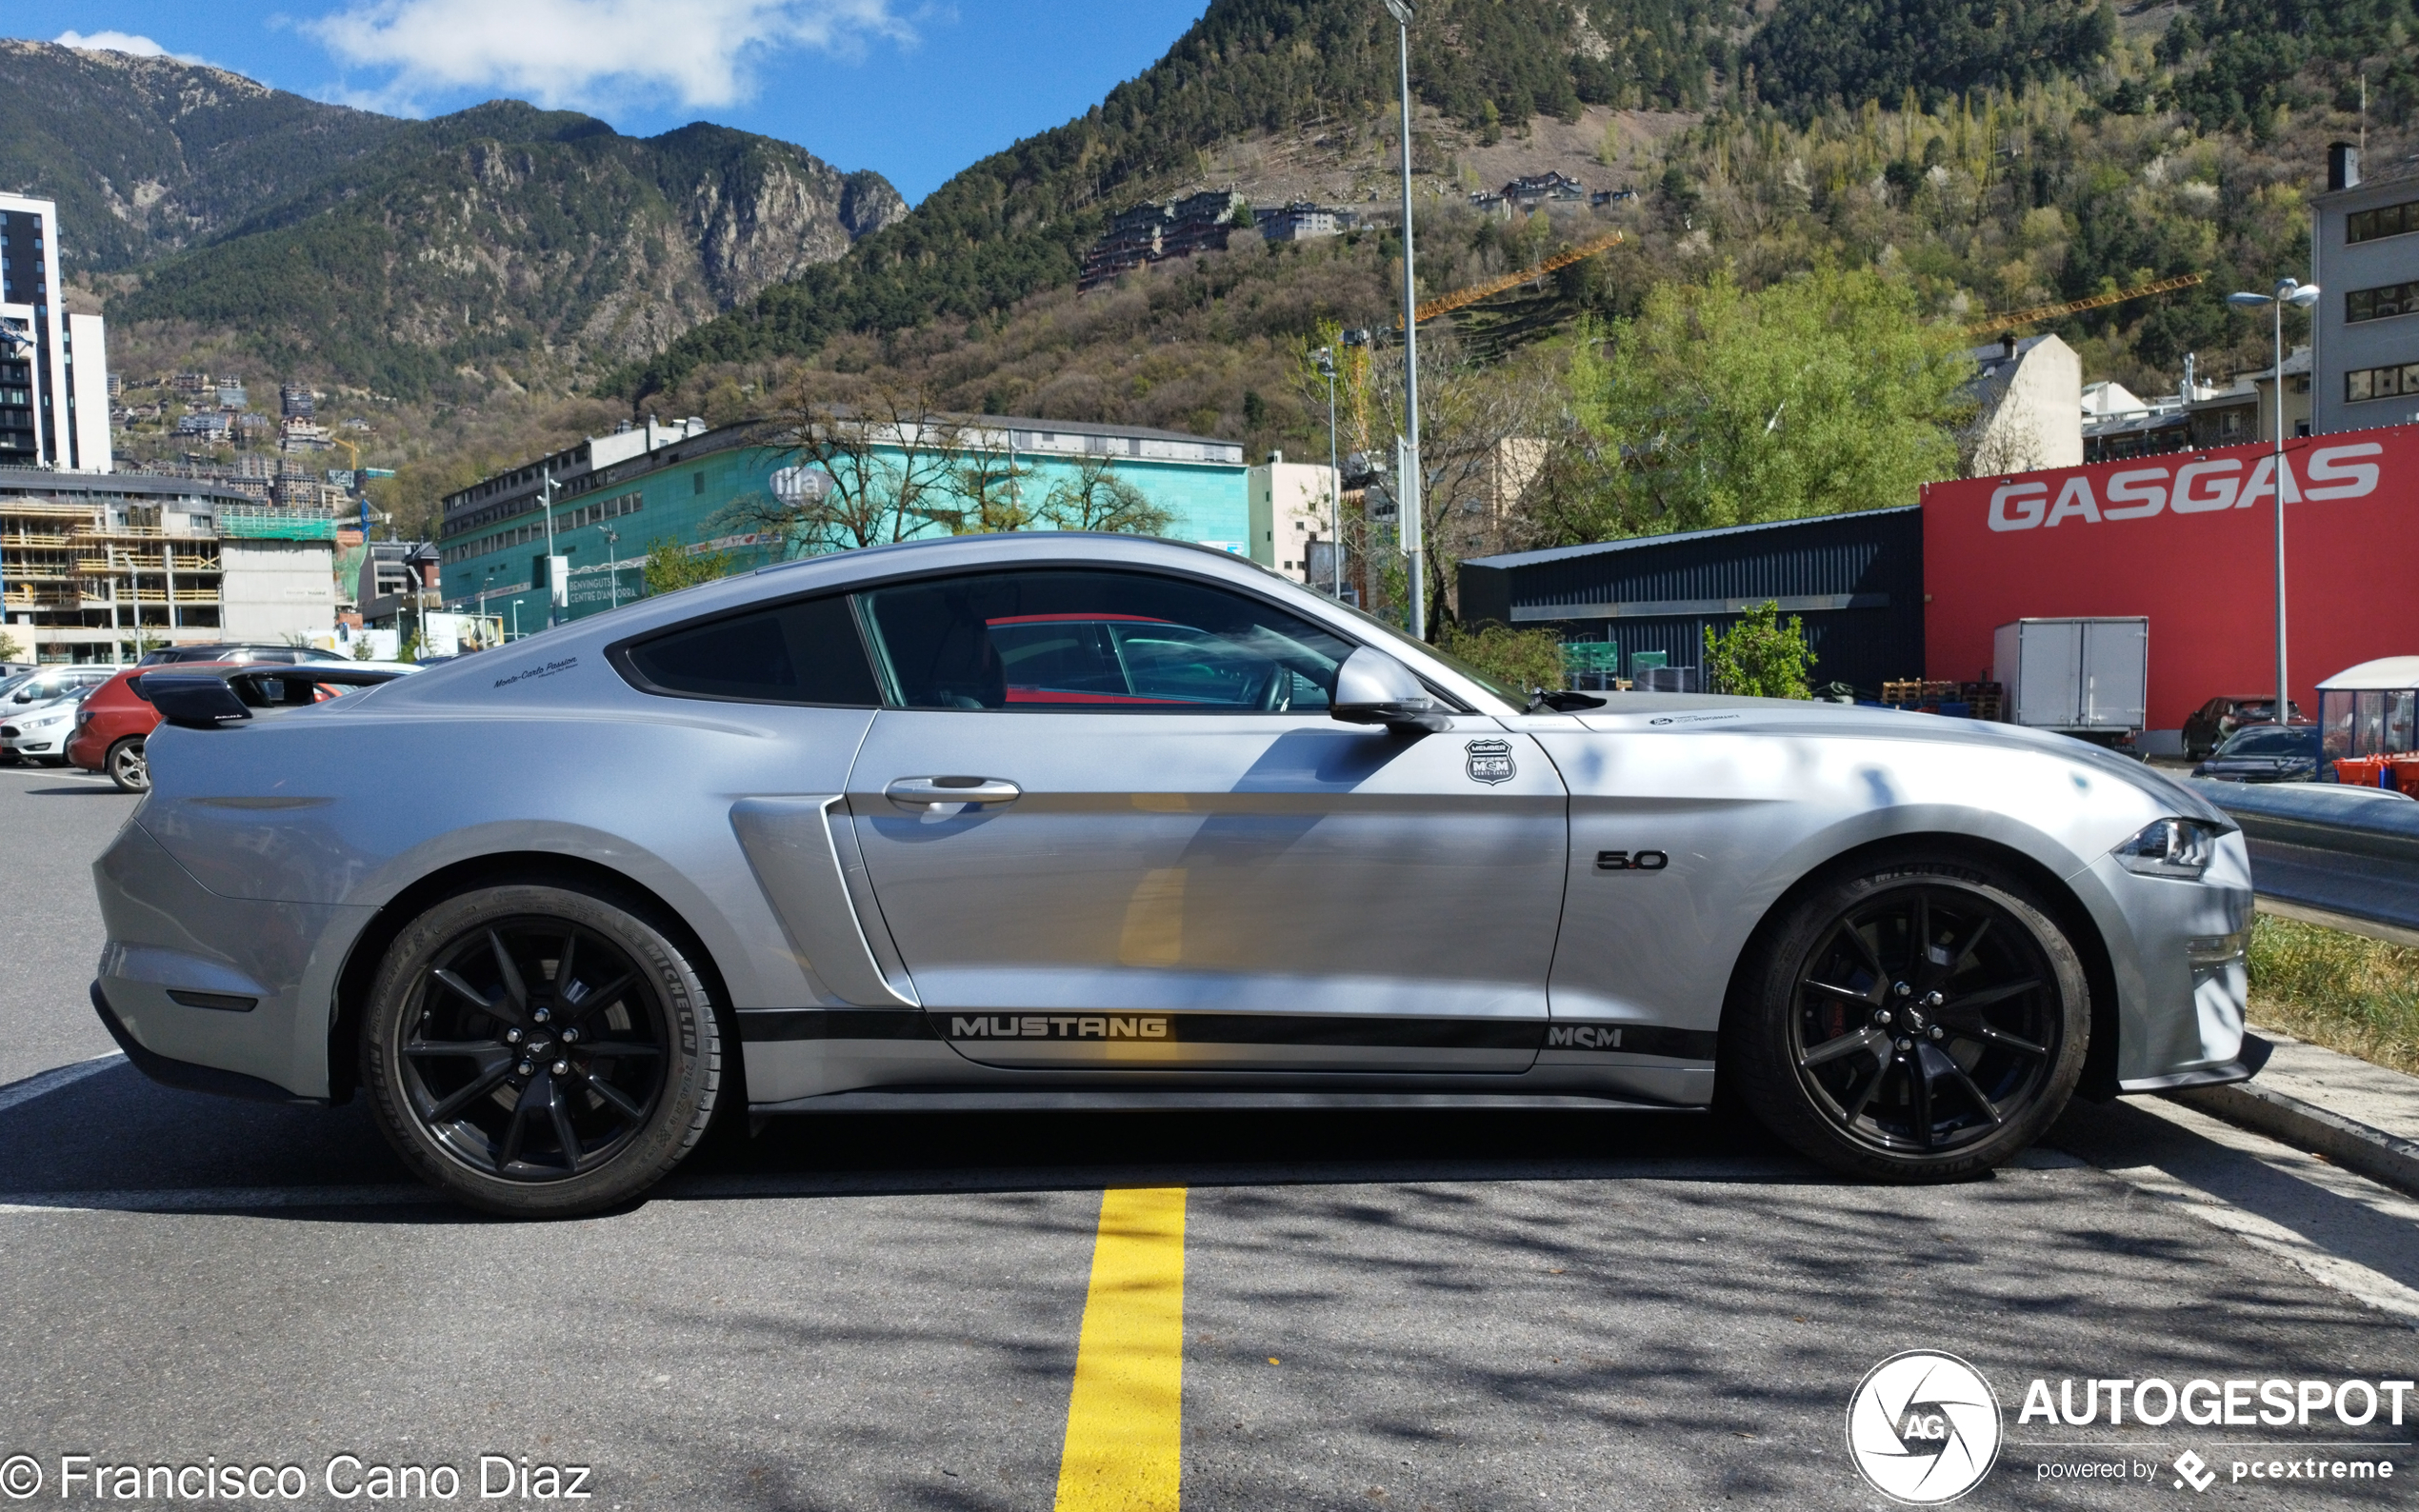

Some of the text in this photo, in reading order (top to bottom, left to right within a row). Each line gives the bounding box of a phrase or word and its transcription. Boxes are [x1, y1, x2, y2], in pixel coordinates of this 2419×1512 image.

[1988, 442, 2383, 532] GASGAS
[570, 577, 612, 591] BENVINGUTS
[570, 587, 637, 603] CENTRE D'ANORRA.
[493, 657, 577, 688] Monte-Carlo Passion
[1596, 850, 1669, 869] 5.0
[372, 1003, 386, 1035] PILOT
[381, 964, 401, 999] SPORT
[645, 943, 697, 1051] MICHELIN
[952, 1017, 1168, 1037] MUSTANG
[1549, 1026, 1622, 1048] MCM
[679, 1064, 695, 1100] 275/40
